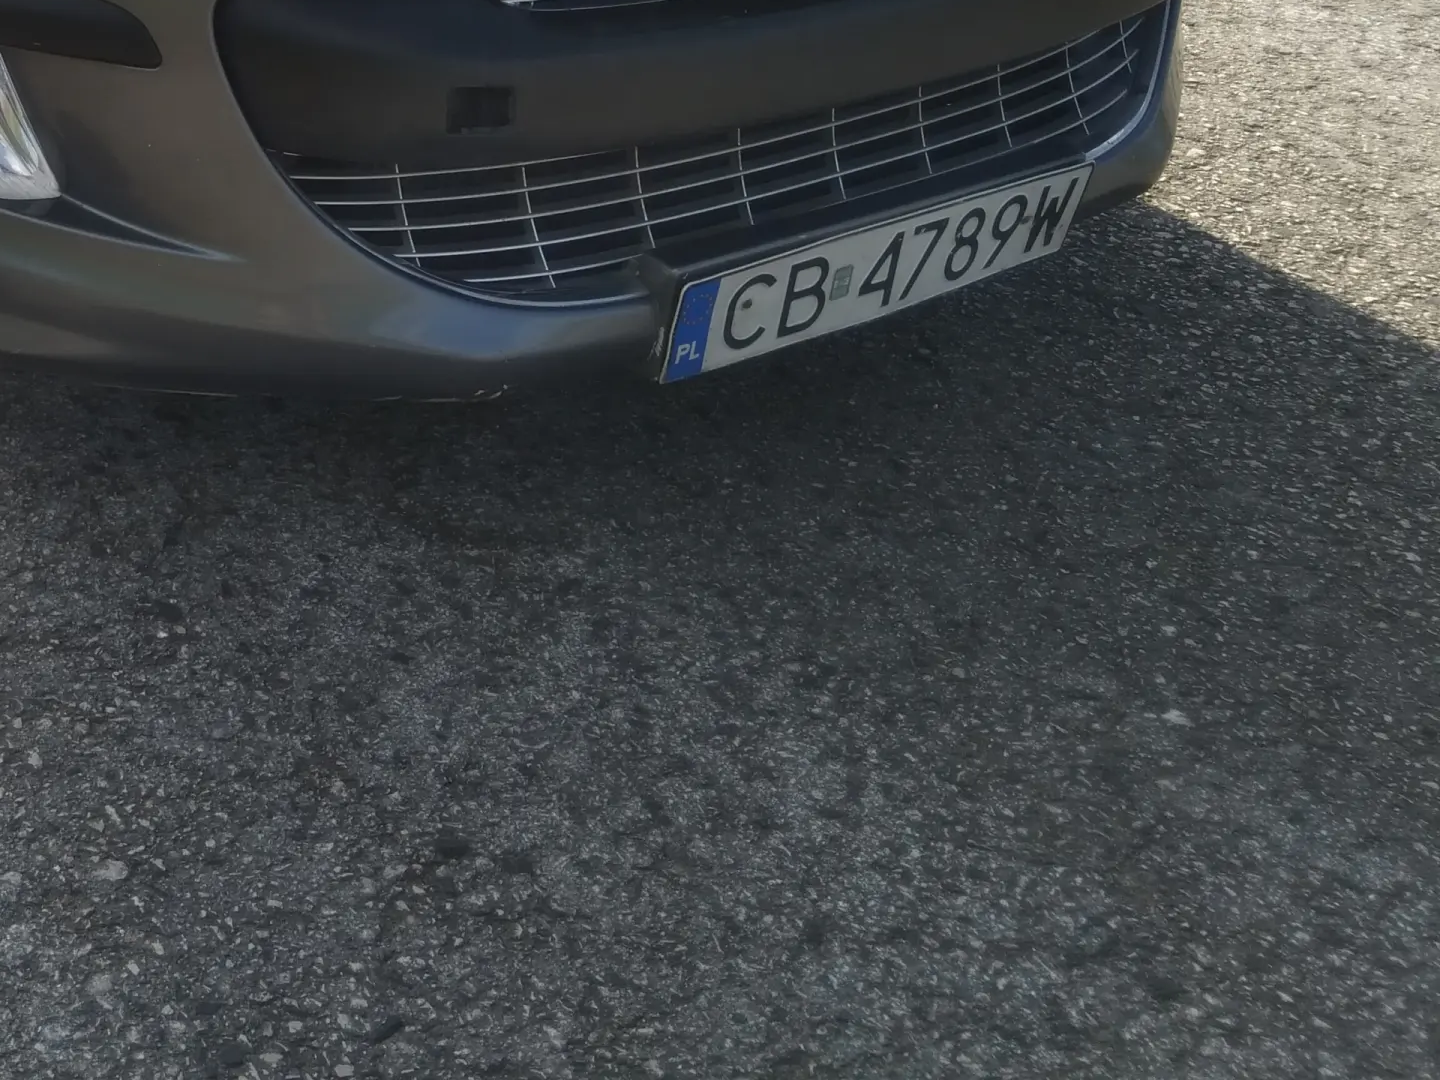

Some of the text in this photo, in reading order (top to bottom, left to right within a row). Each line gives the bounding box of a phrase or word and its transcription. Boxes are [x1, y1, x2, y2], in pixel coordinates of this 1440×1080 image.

[723, 176, 1079, 350] CB 4789W
[674, 340, 700, 365] PL
